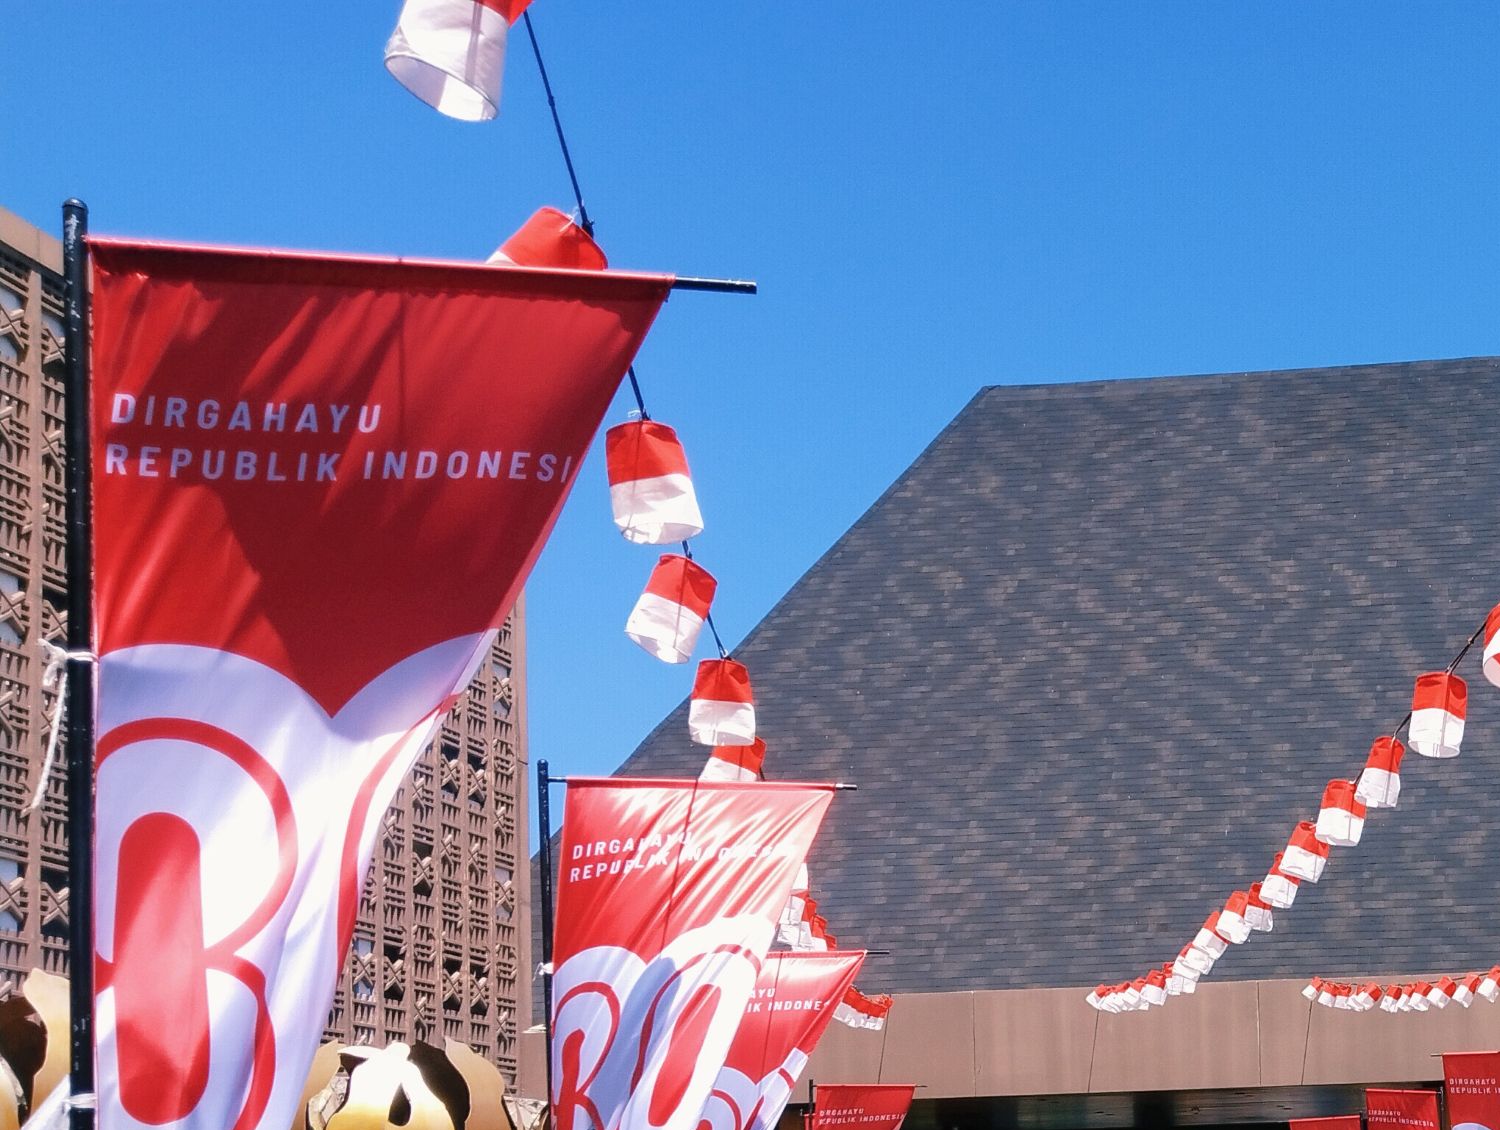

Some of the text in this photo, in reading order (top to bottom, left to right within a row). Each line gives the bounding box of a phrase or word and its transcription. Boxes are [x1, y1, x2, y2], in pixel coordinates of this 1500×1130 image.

[111, 393, 382, 434] DIRGAHAYU
[105, 444, 574, 483] REPUBLIK INDONESI
[767, 1000, 823, 1013] INDONE
[1450, 1087, 1491, 1095] REPUBLIK
